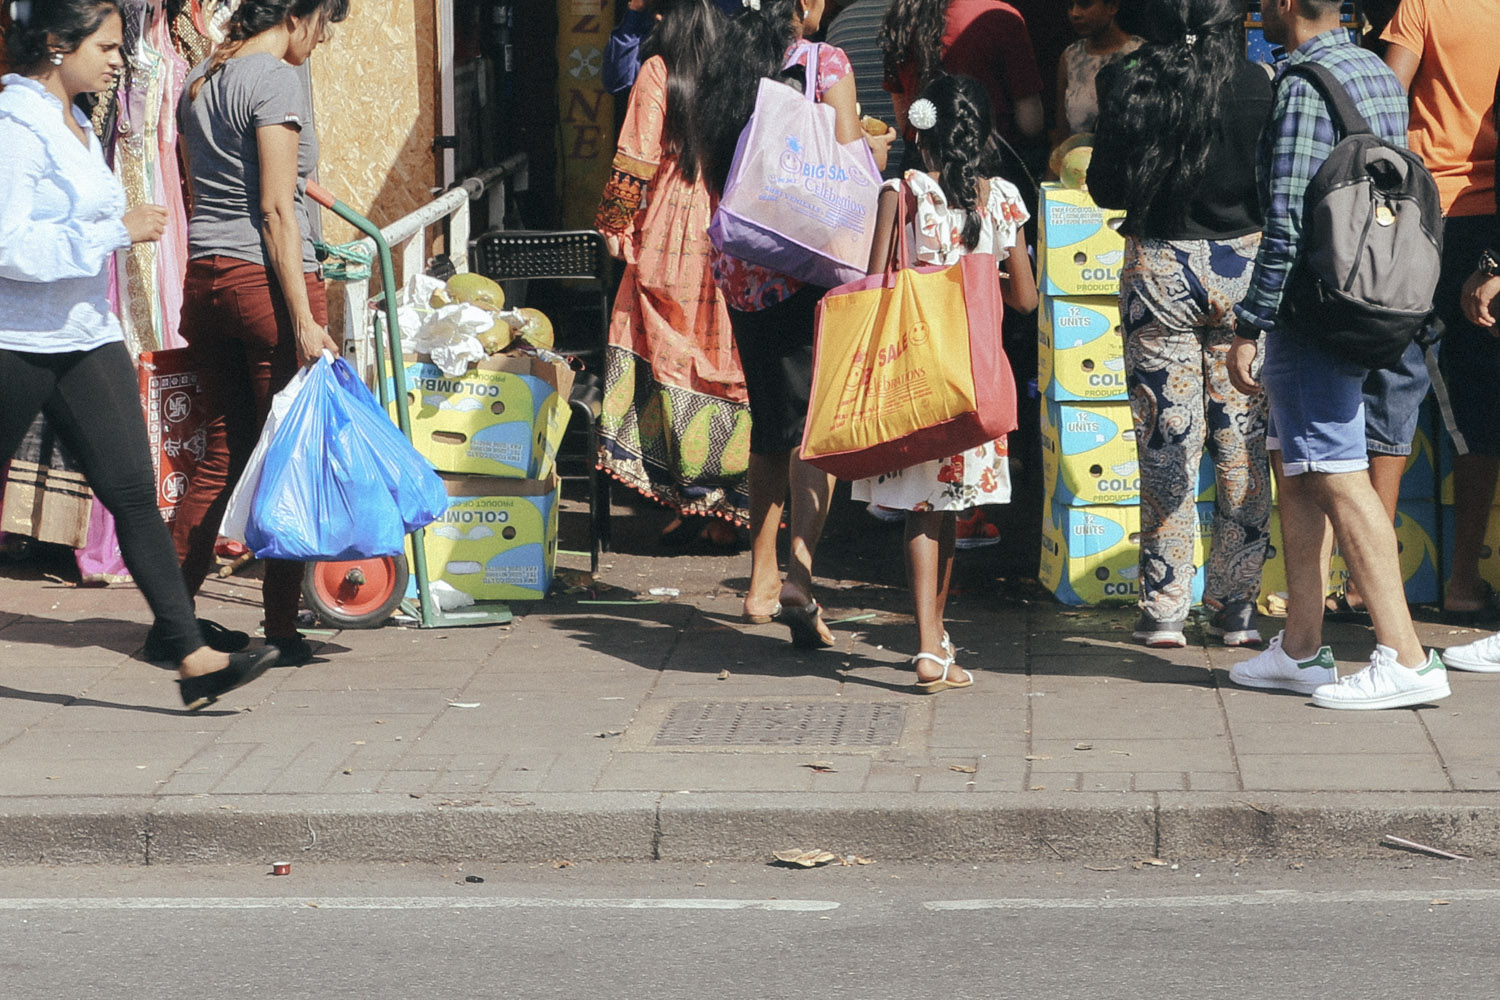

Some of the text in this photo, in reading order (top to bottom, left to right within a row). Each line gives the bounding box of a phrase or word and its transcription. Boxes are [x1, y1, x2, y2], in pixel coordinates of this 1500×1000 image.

[802, 162, 826, 179] BIG
[1077, 284, 1114, 292] PRODUCT
[1069, 307, 1081, 317] 12
[1060, 317, 1091, 327] UNITS
[878, 332, 908, 367] SALE
[415, 377, 500, 398] COLOMBA
[1077, 412, 1089, 421] 12
[1068, 423, 1099, 433] UNITS
[477, 500, 514, 508] PRODUCT
[437, 511, 509, 524] COLOM
[1083, 516, 1095, 525] 12
[1074, 525, 1105, 535] UNITS
